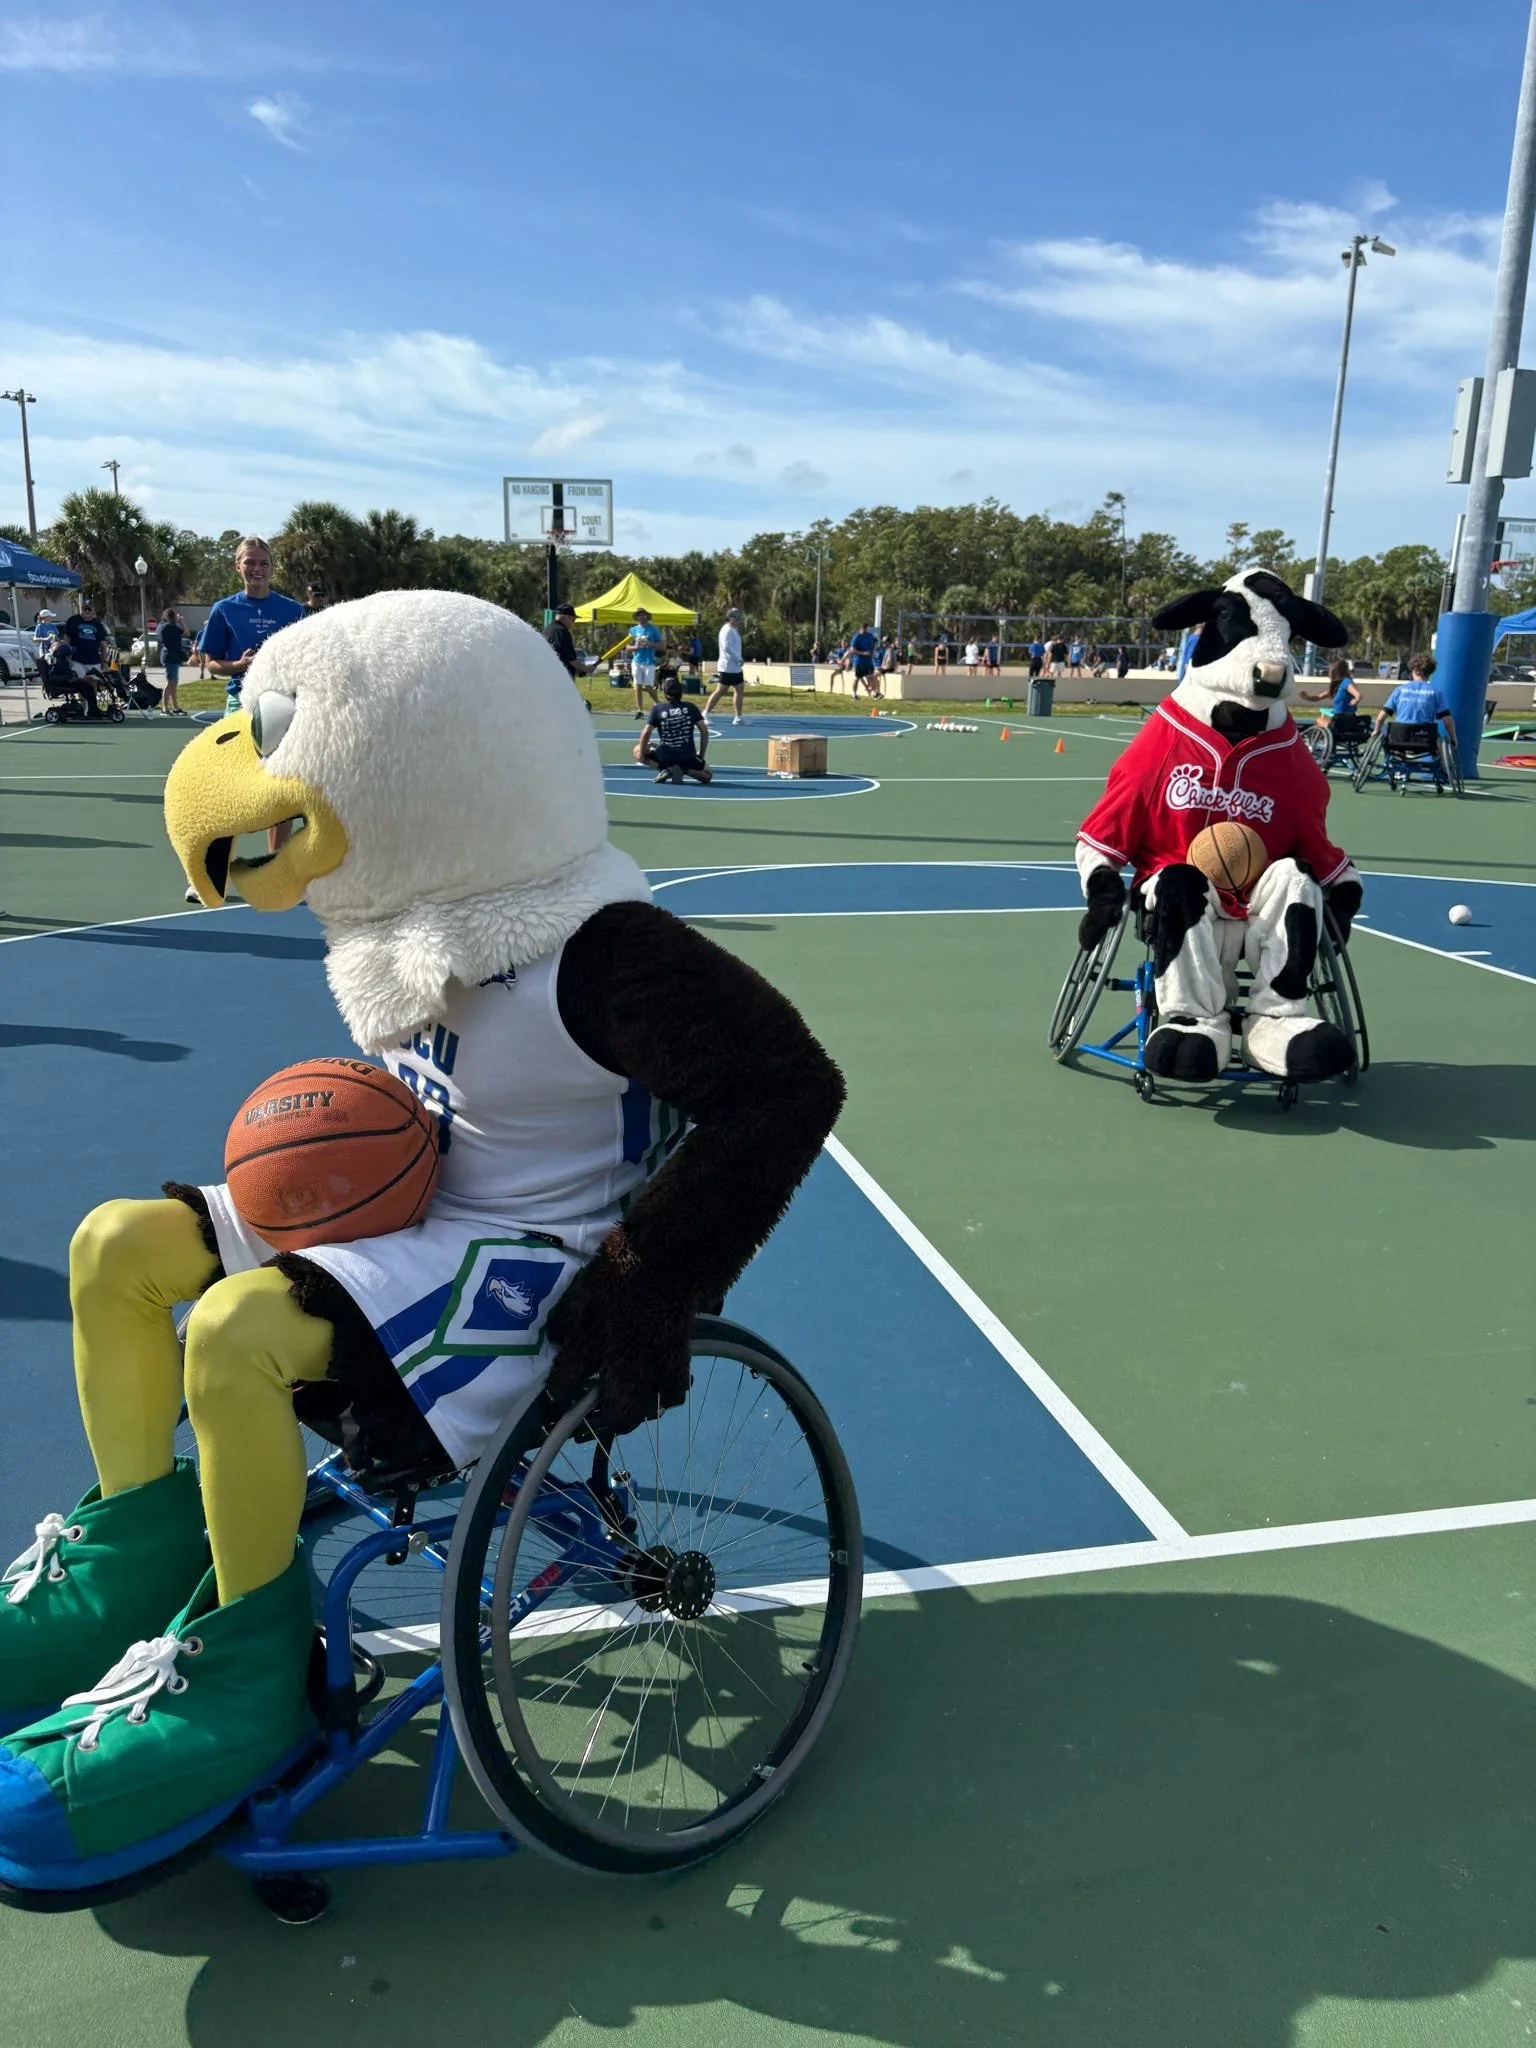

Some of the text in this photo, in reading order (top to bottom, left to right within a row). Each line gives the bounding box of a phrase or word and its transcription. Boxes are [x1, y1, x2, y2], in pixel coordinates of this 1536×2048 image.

[512, 484, 522, 495] NO
[568, 485, 586, 496] FROM
[581, 515, 602, 526] COURT
[244, 1090, 335, 1126] VARSITY
